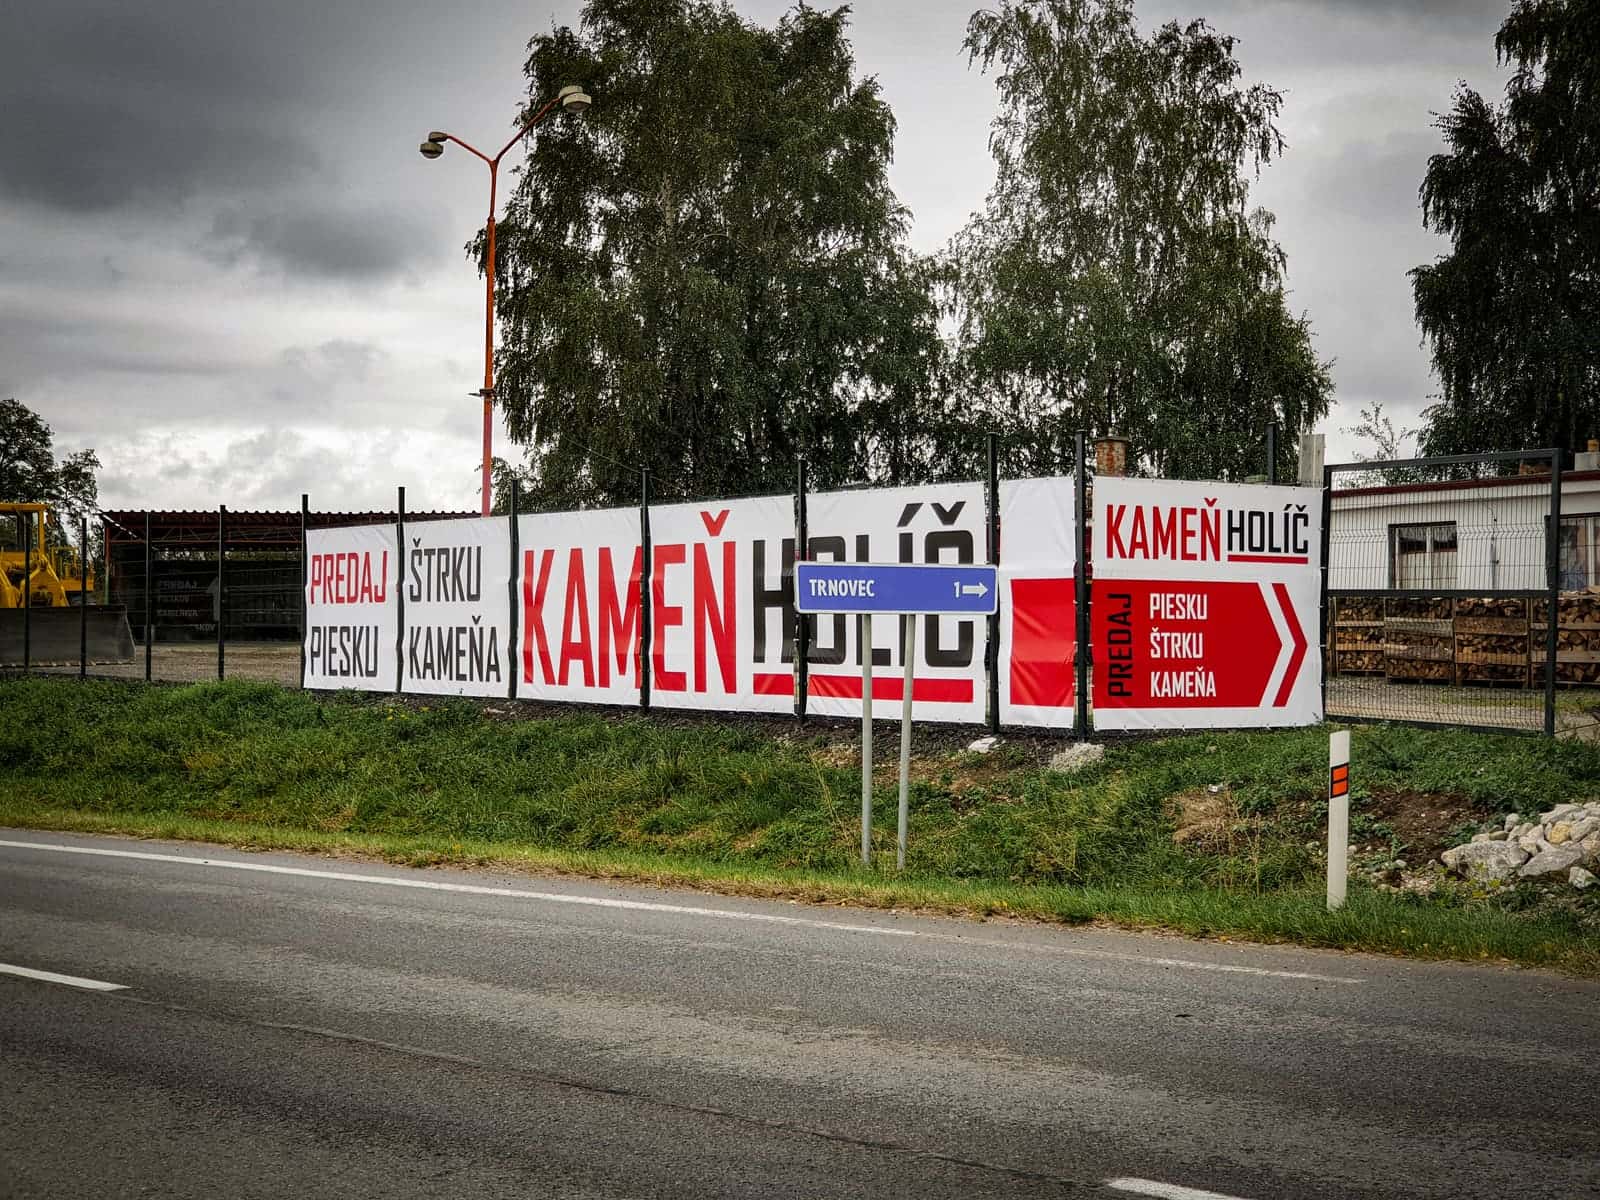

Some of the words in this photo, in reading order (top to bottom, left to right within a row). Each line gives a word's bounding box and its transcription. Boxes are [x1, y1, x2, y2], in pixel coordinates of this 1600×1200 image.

[1106, 497, 1221, 562] KAMEŇ
[1228, 503, 1309, 554] HOLÍČ
[310, 550, 387, 605] PREDAJ
[409, 537, 482, 603] ŠTRKU
[809, 578, 876, 599] TRNOVEC
[953, 581, 960, 599] 1
[522, 509, 737, 694] KAMEŇ
[1149, 593, 1208, 621] PIESKU
[310, 624, 379, 678] PIESKU
[409, 615, 502, 683] KAMEŇA
[1107, 593, 1133, 697] PREDAJ
[1150, 627, 1203, 659] ŠTRKU
[1150, 666, 1217, 698] KAMEŇA
